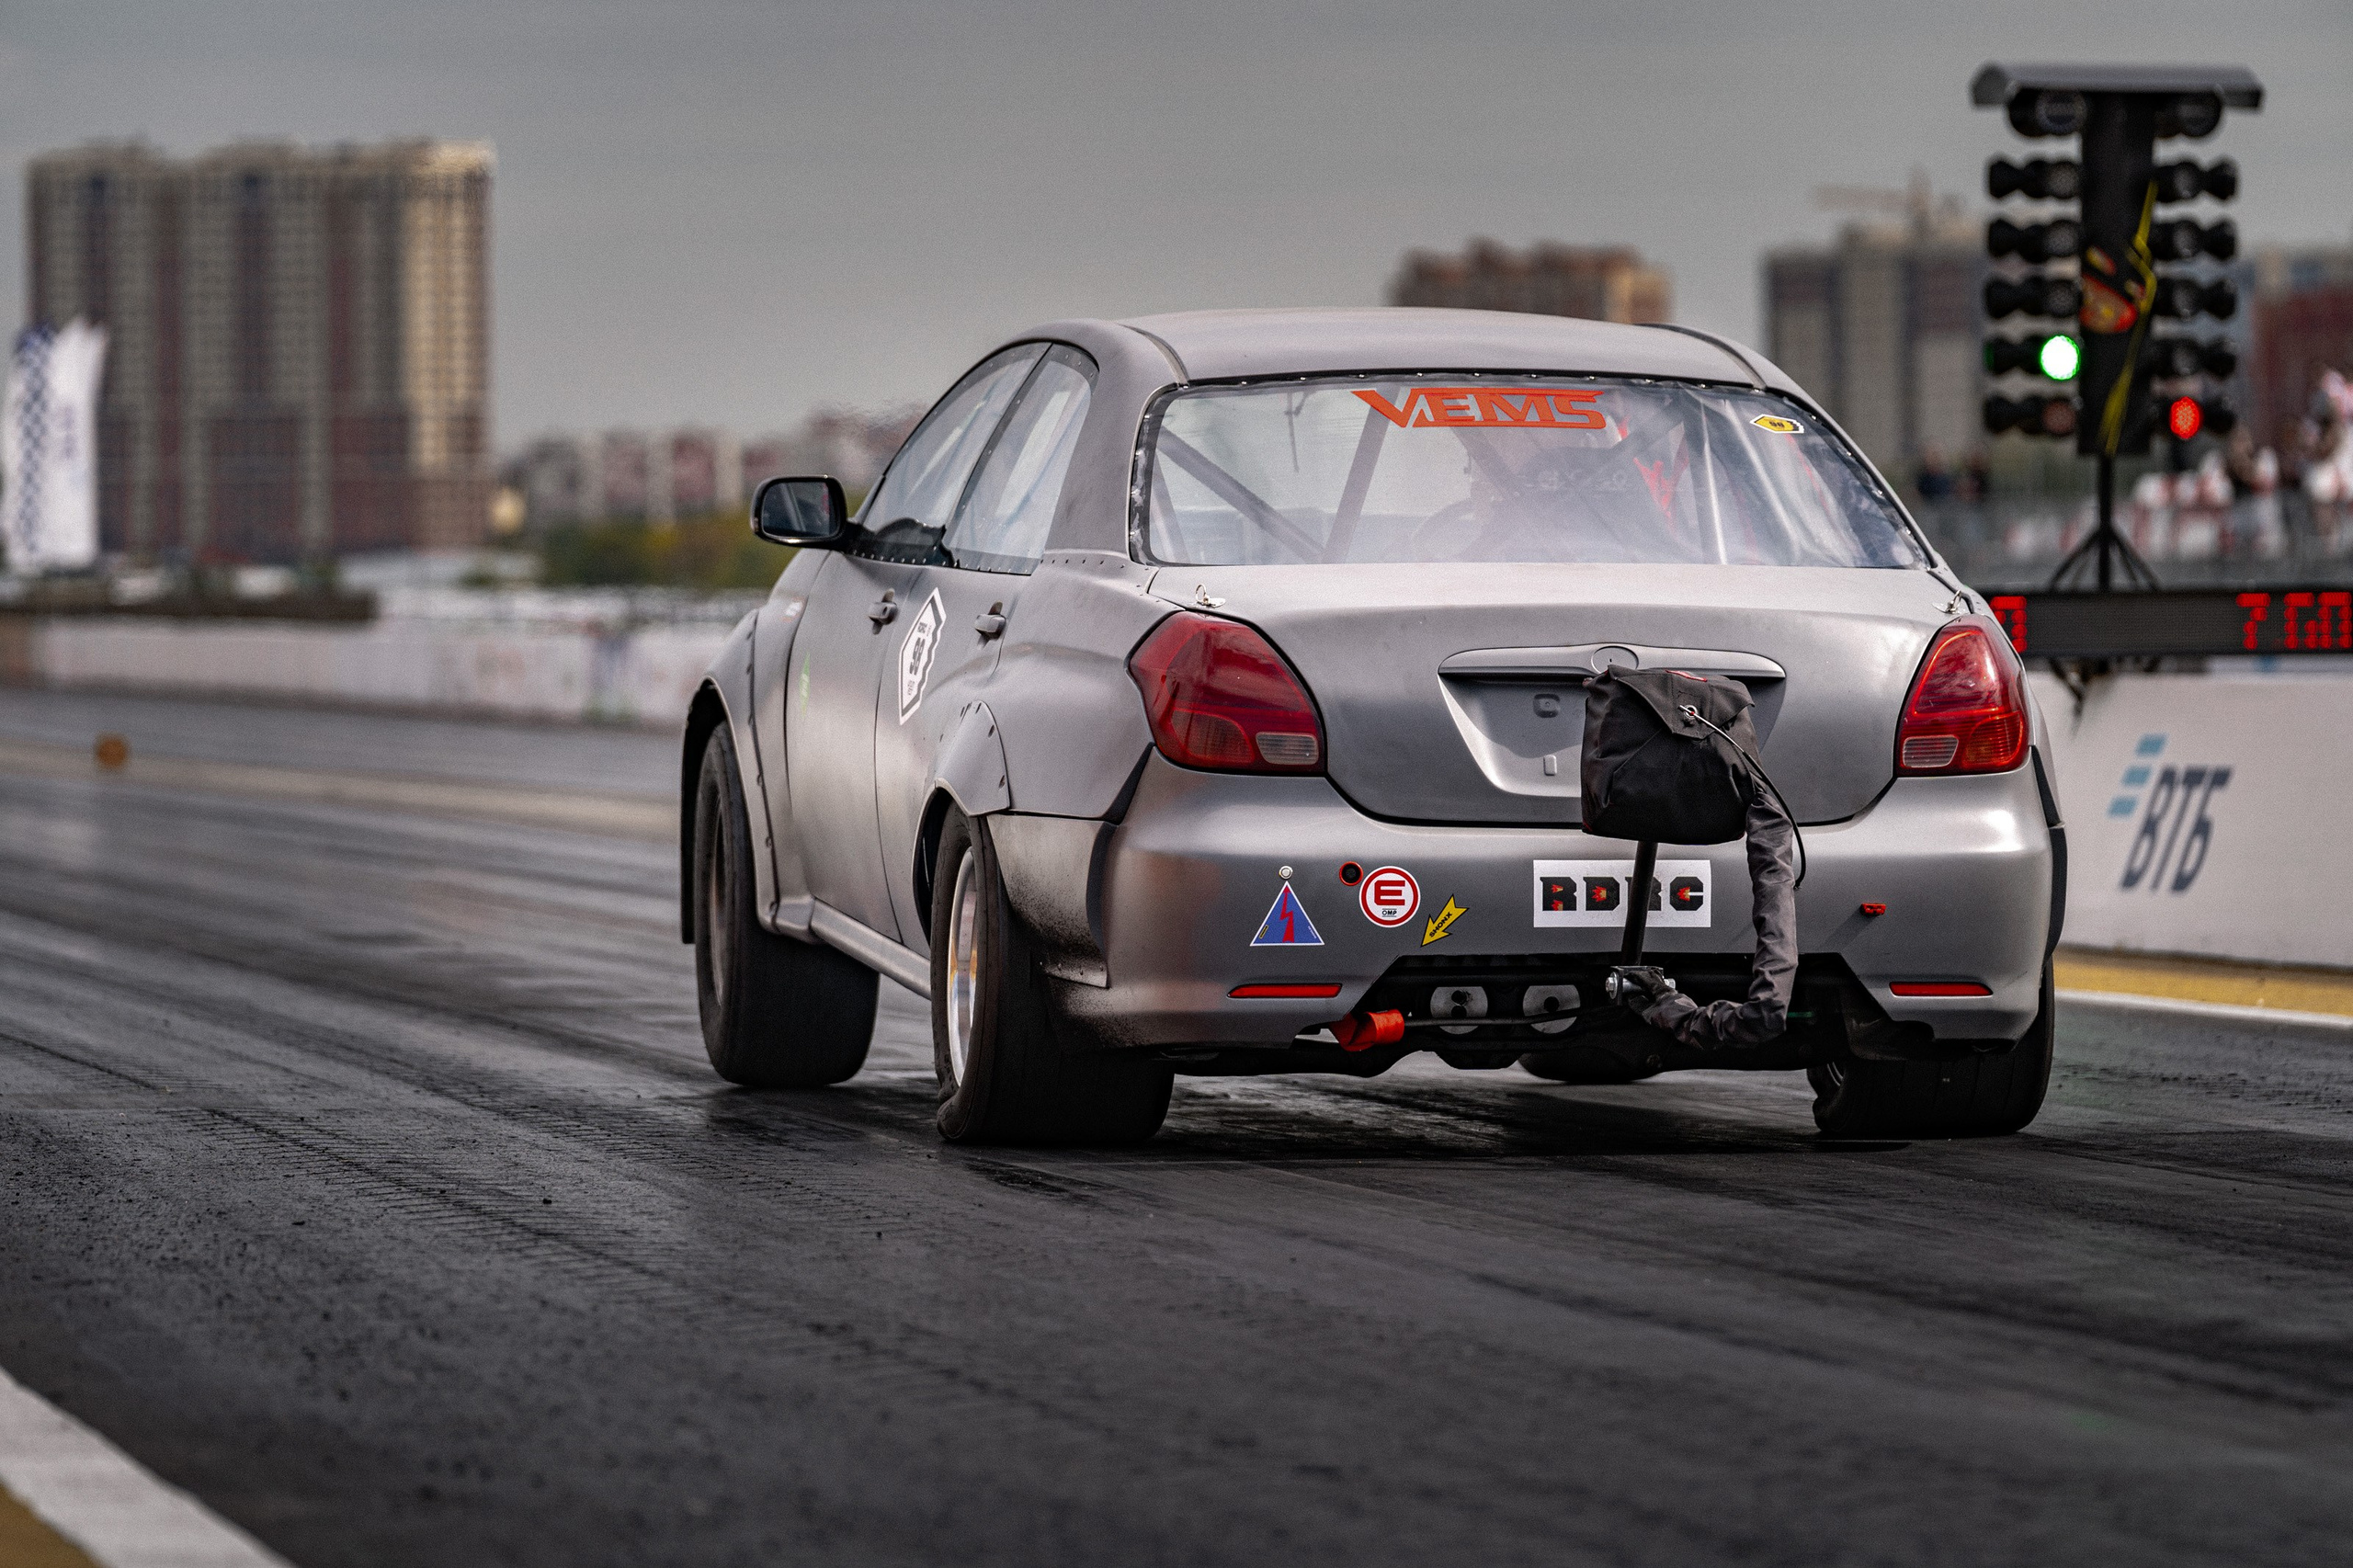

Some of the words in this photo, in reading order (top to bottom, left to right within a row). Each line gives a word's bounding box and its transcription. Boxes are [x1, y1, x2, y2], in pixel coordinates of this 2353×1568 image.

[1350, 387, 1607, 429] VEMS
[2120, 765, 2231, 894] ВТБ
[1374, 880, 1405, 906] E
[1428, 911, 1453, 938] SHONX
